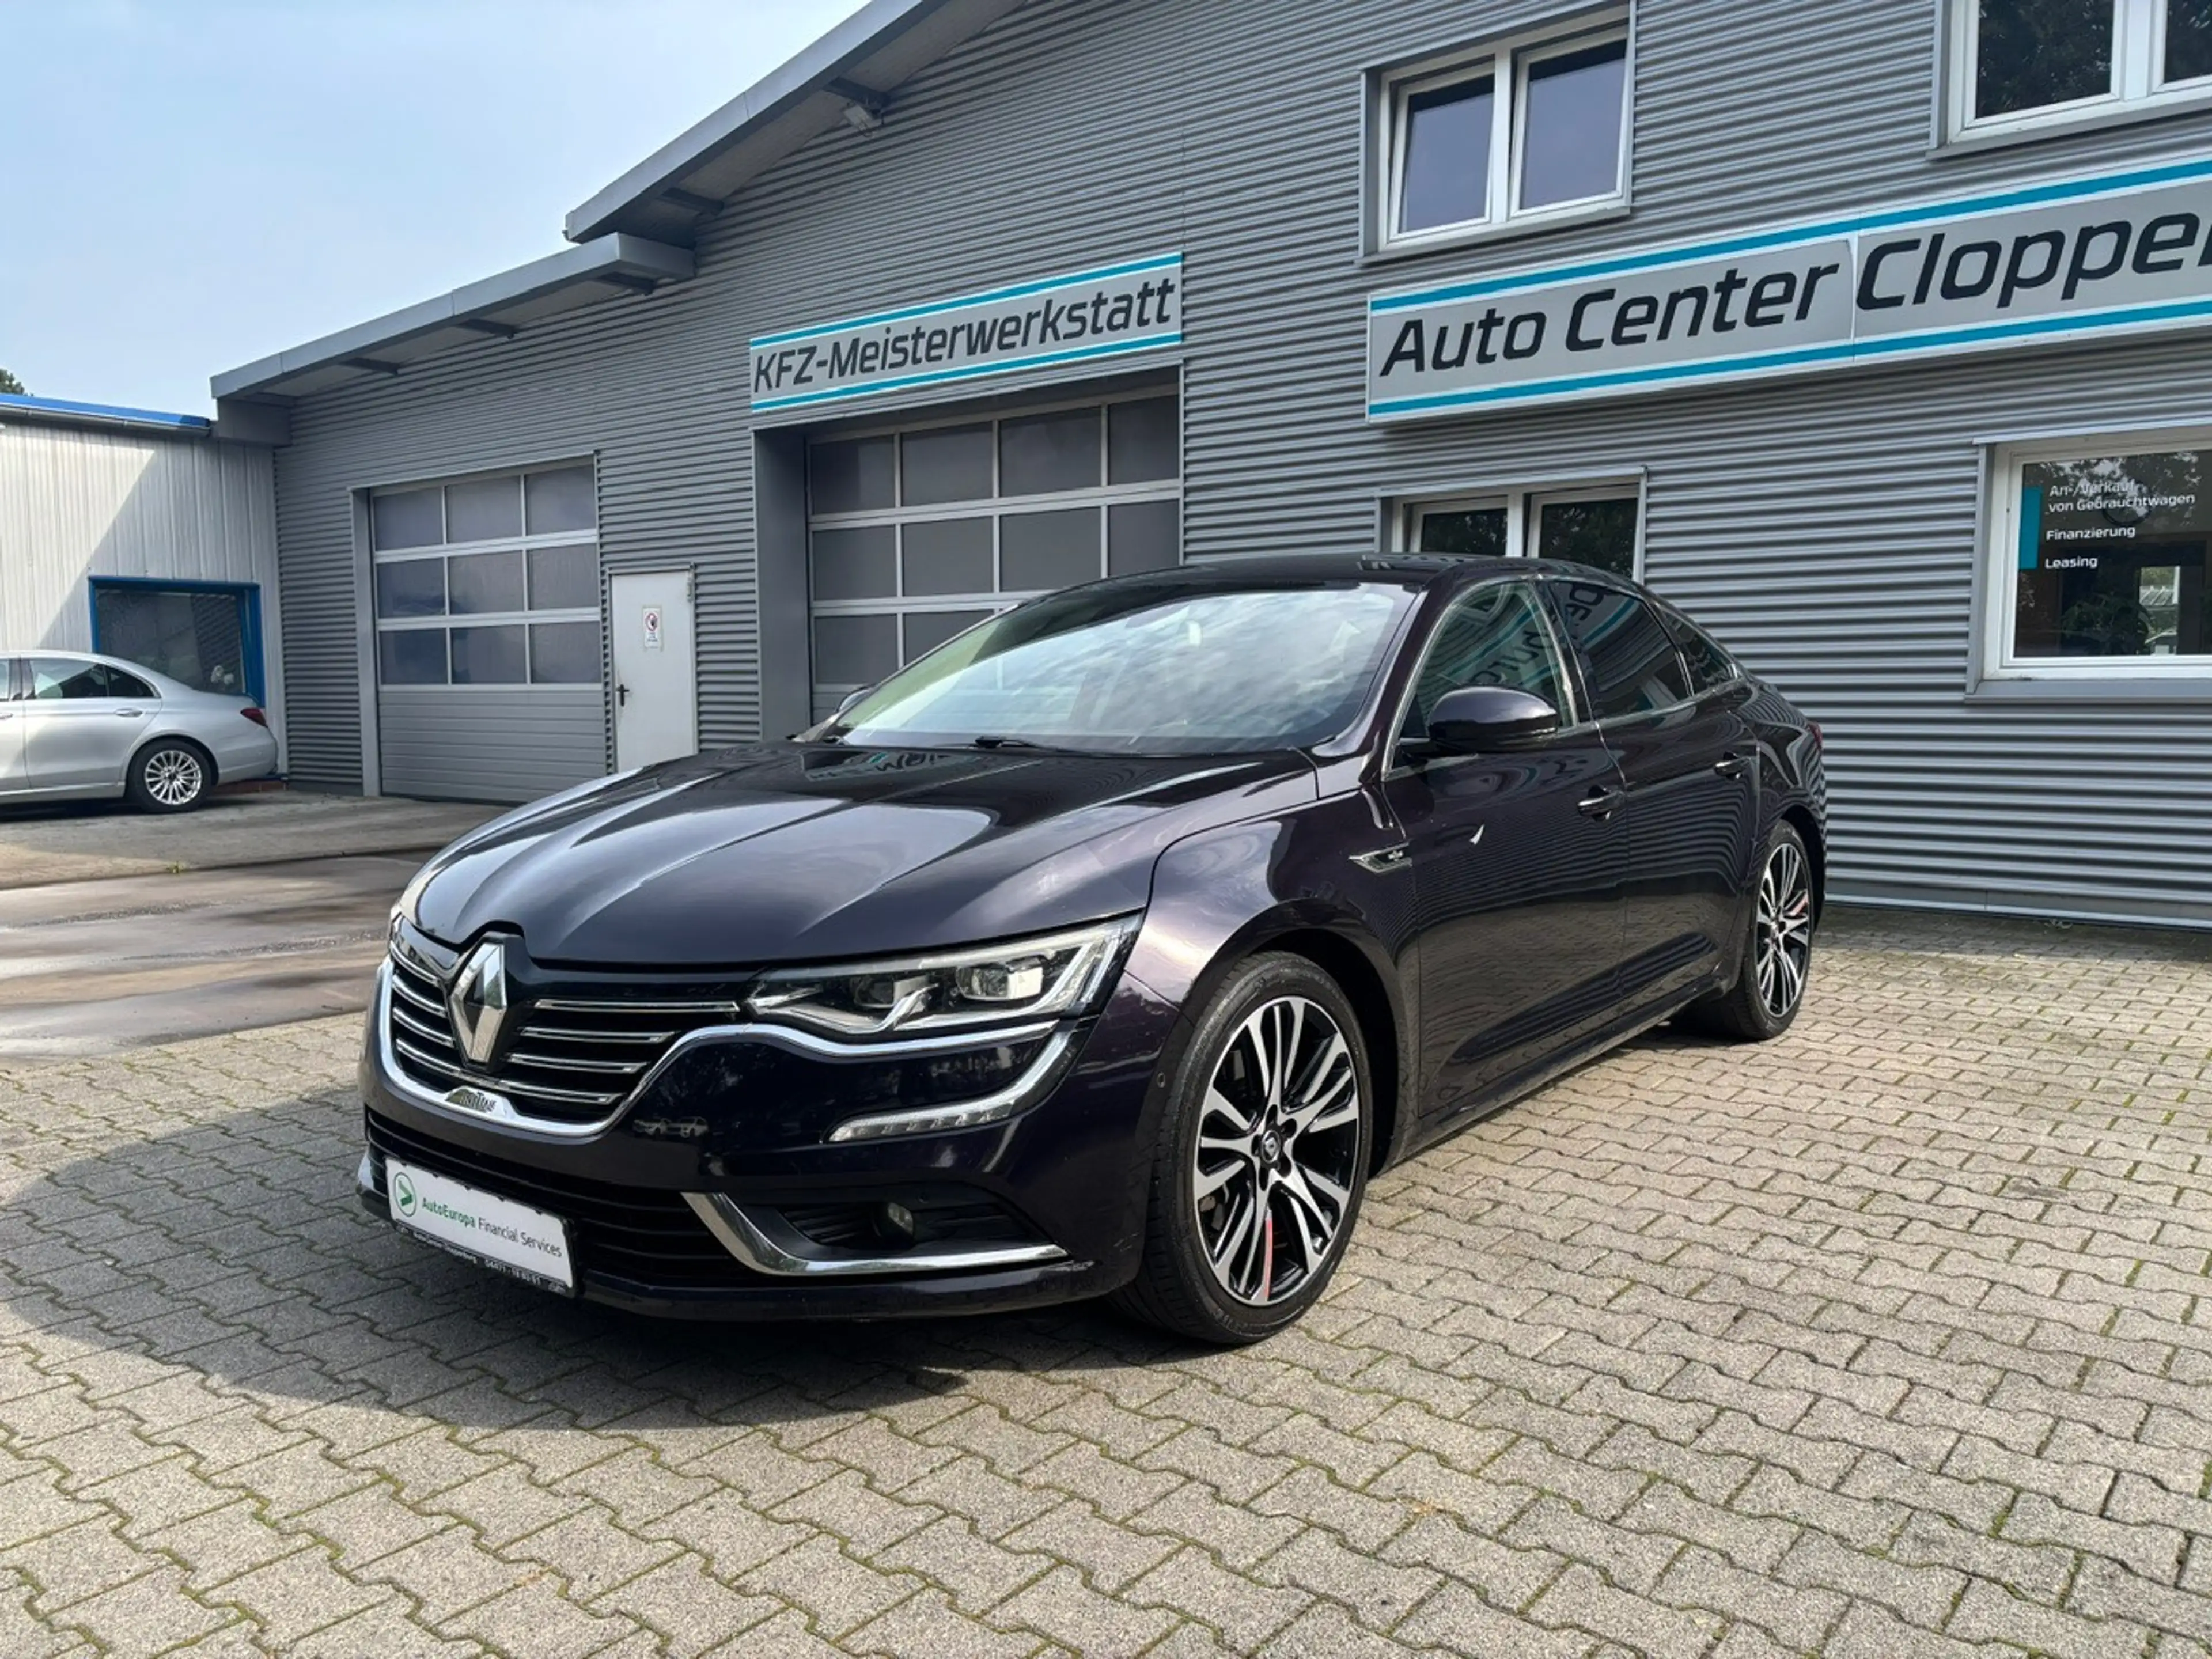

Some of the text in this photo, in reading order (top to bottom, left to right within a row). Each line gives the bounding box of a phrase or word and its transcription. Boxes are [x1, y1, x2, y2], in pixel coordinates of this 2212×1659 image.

[1379, 212, 2212, 377] Auto Center Cloppe
[754, 278, 1176, 393] KFZ-Meisterwerkstatt
[2048, 494, 2196, 513] von Gebrauchtwagen
[2046, 527, 2136, 541] Finanzierung
[2045, 555, 2099, 569] Leasing
[422, 1197, 563, 1258] AutoEuropa Financial Services
